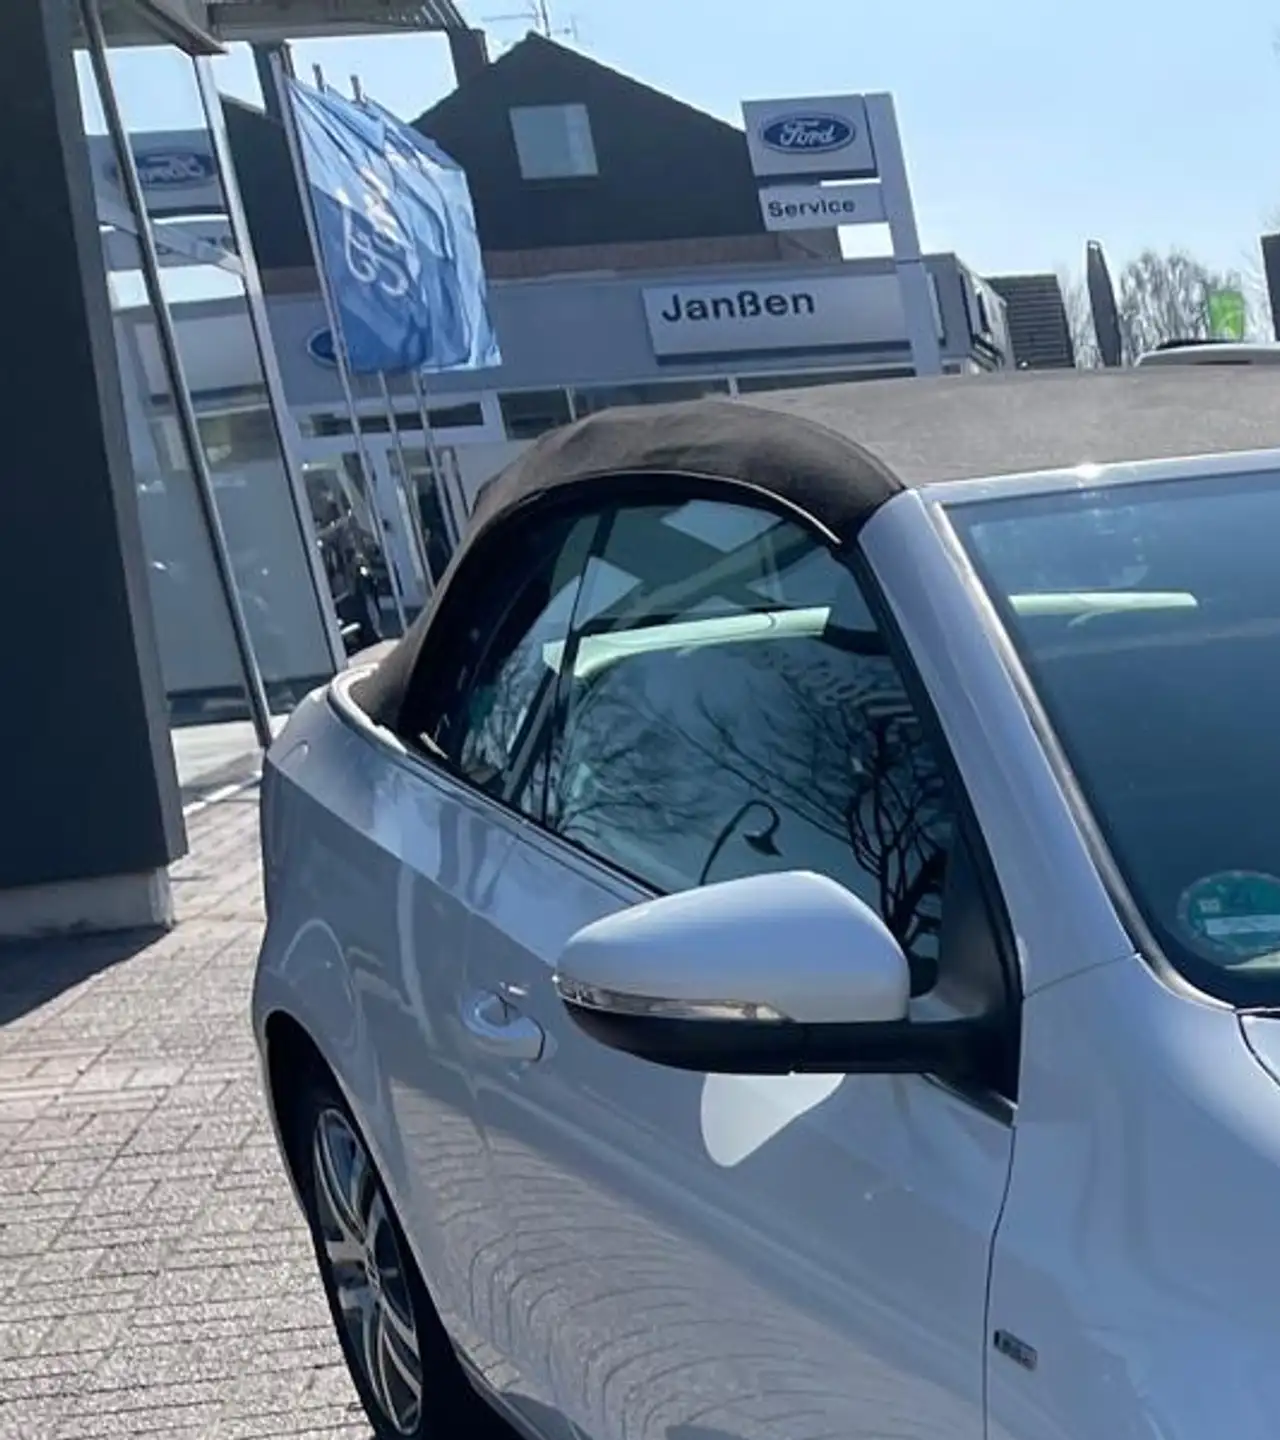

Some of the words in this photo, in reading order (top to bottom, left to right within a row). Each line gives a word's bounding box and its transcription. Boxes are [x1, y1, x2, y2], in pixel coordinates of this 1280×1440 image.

[779, 119, 836, 147] Ford
[767, 199, 856, 218] Service
[661, 289, 815, 323] Janßen
